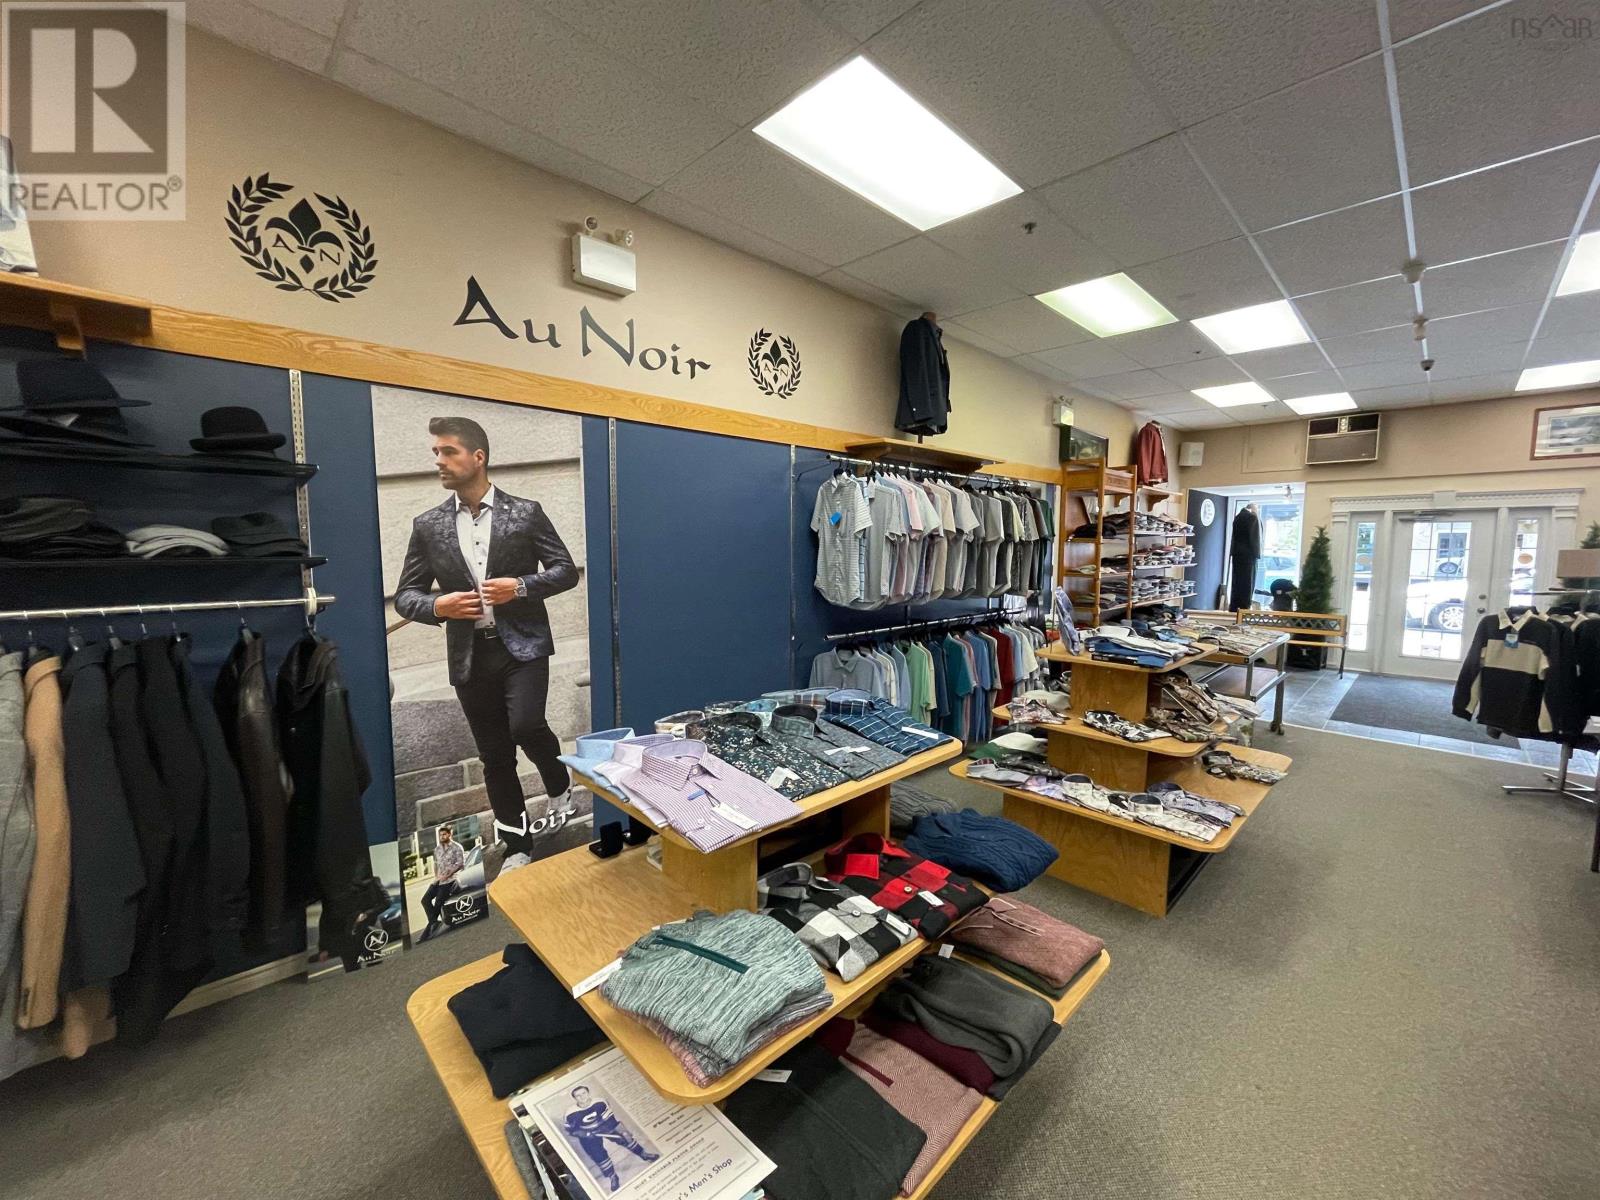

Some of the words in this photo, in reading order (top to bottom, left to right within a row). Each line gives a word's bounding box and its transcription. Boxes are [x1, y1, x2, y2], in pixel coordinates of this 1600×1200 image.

[453, 275, 562, 348] Au
[580, 305, 711, 380] Noir
[493, 808, 577, 846] Noir
[689, 1173, 713, 1193] Men's
[712, 1158, 733, 1174] Shop
